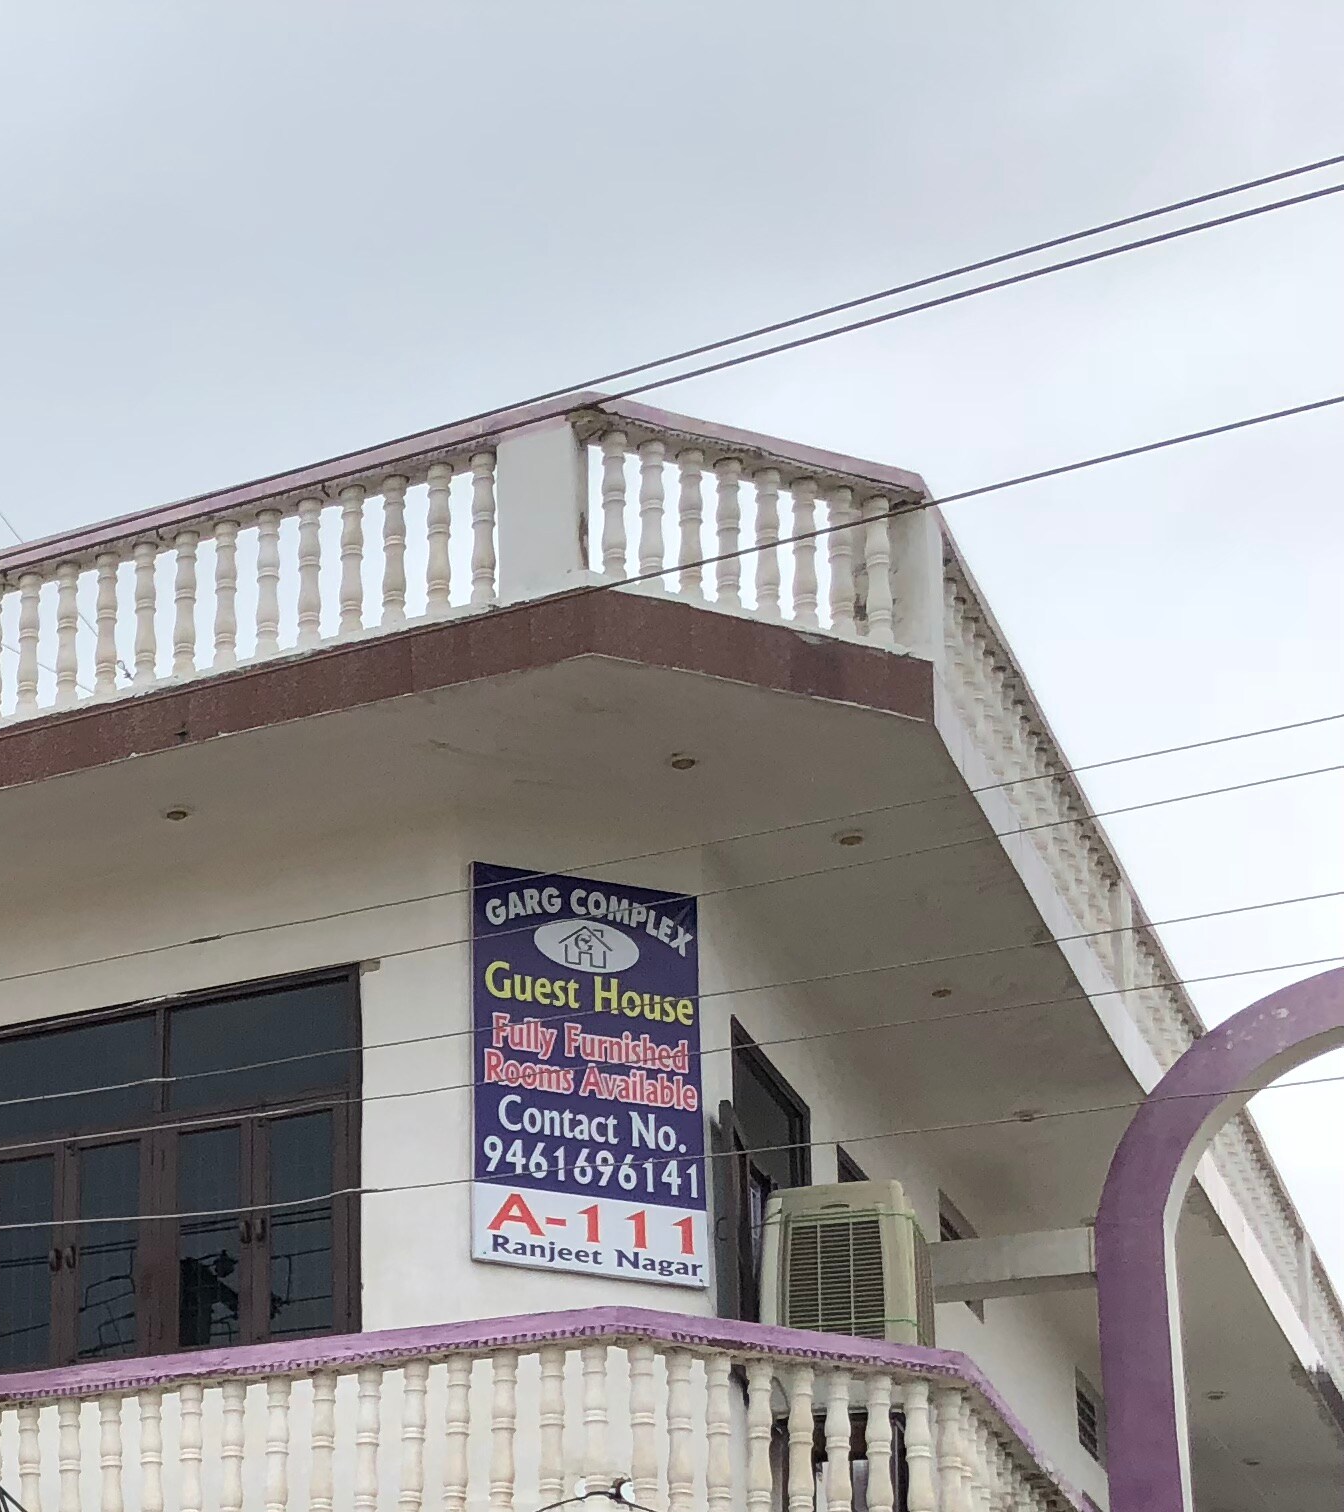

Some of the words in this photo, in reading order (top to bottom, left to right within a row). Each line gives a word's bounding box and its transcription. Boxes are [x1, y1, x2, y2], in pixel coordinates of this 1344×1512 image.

[485, 887, 562, 926] GARG
[570, 888, 694, 957] COMPLEX
[484, 960, 580, 1009] Guest
[594, 976, 695, 1025] House
[492, 1011, 558, 1061] Fully
[565, 1022, 689, 1074] Furnished
[484, 1048, 575, 1095] Rooms
[579, 1062, 698, 1112] Available
[498, 1094, 618, 1146] Contact
[629, 1111, 687, 1154] No.
[483, 1136, 699, 1199] 9461696141
[491, 1233, 603, 1266] Ranjeet
[615, 1249, 703, 1279] Nagar
